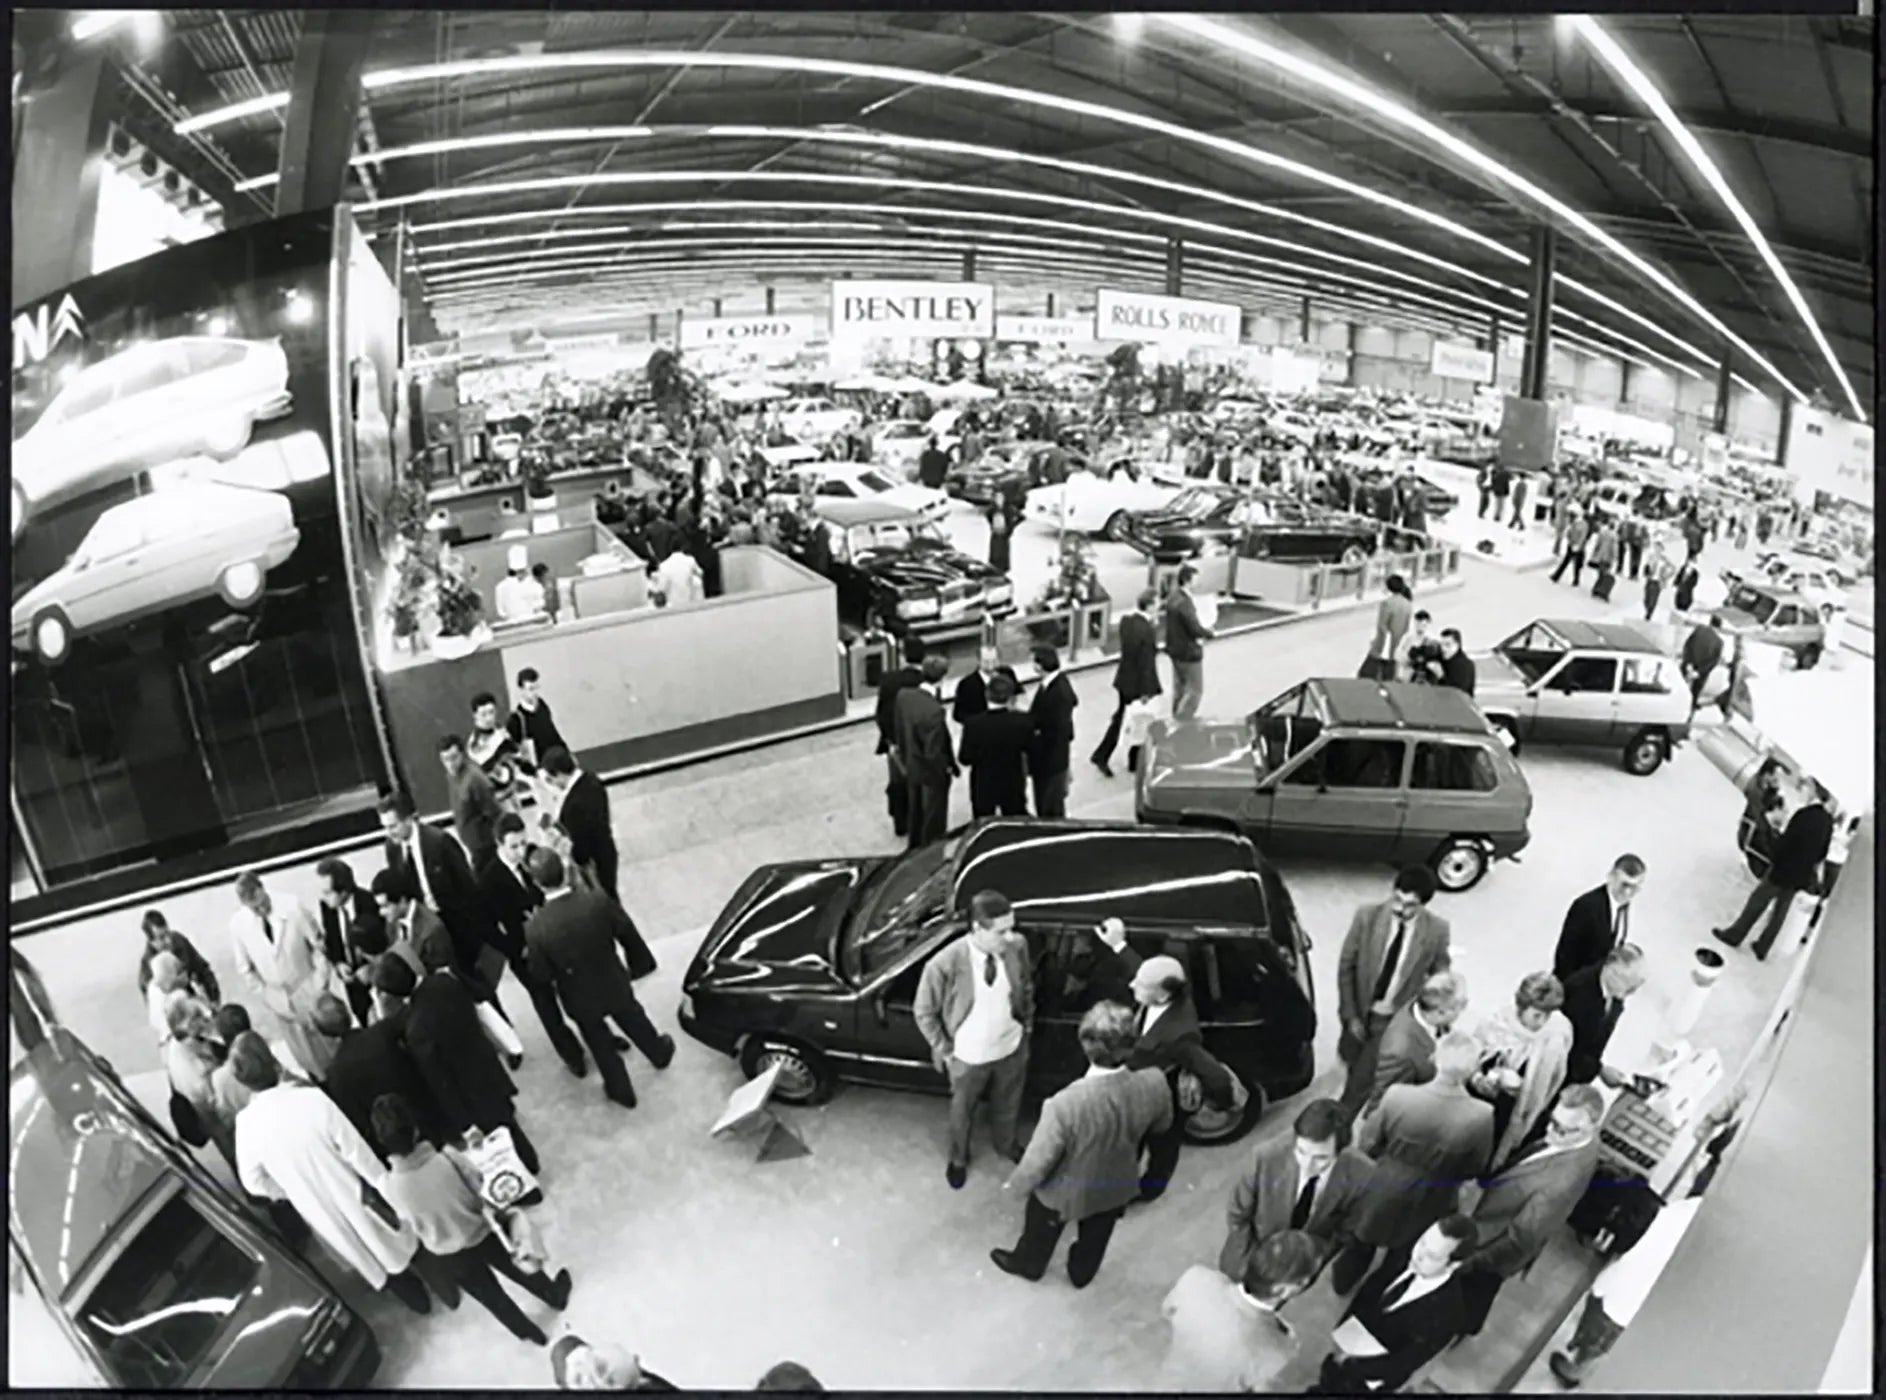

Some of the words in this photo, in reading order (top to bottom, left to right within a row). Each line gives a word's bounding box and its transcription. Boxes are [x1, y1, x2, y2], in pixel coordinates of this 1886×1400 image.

[844, 296, 982, 321] BENTLEY
[1111, 304, 1170, 330] ROLLS
[1178, 311, 1226, 334] ROYCE
[706, 323, 791, 339] FORD
